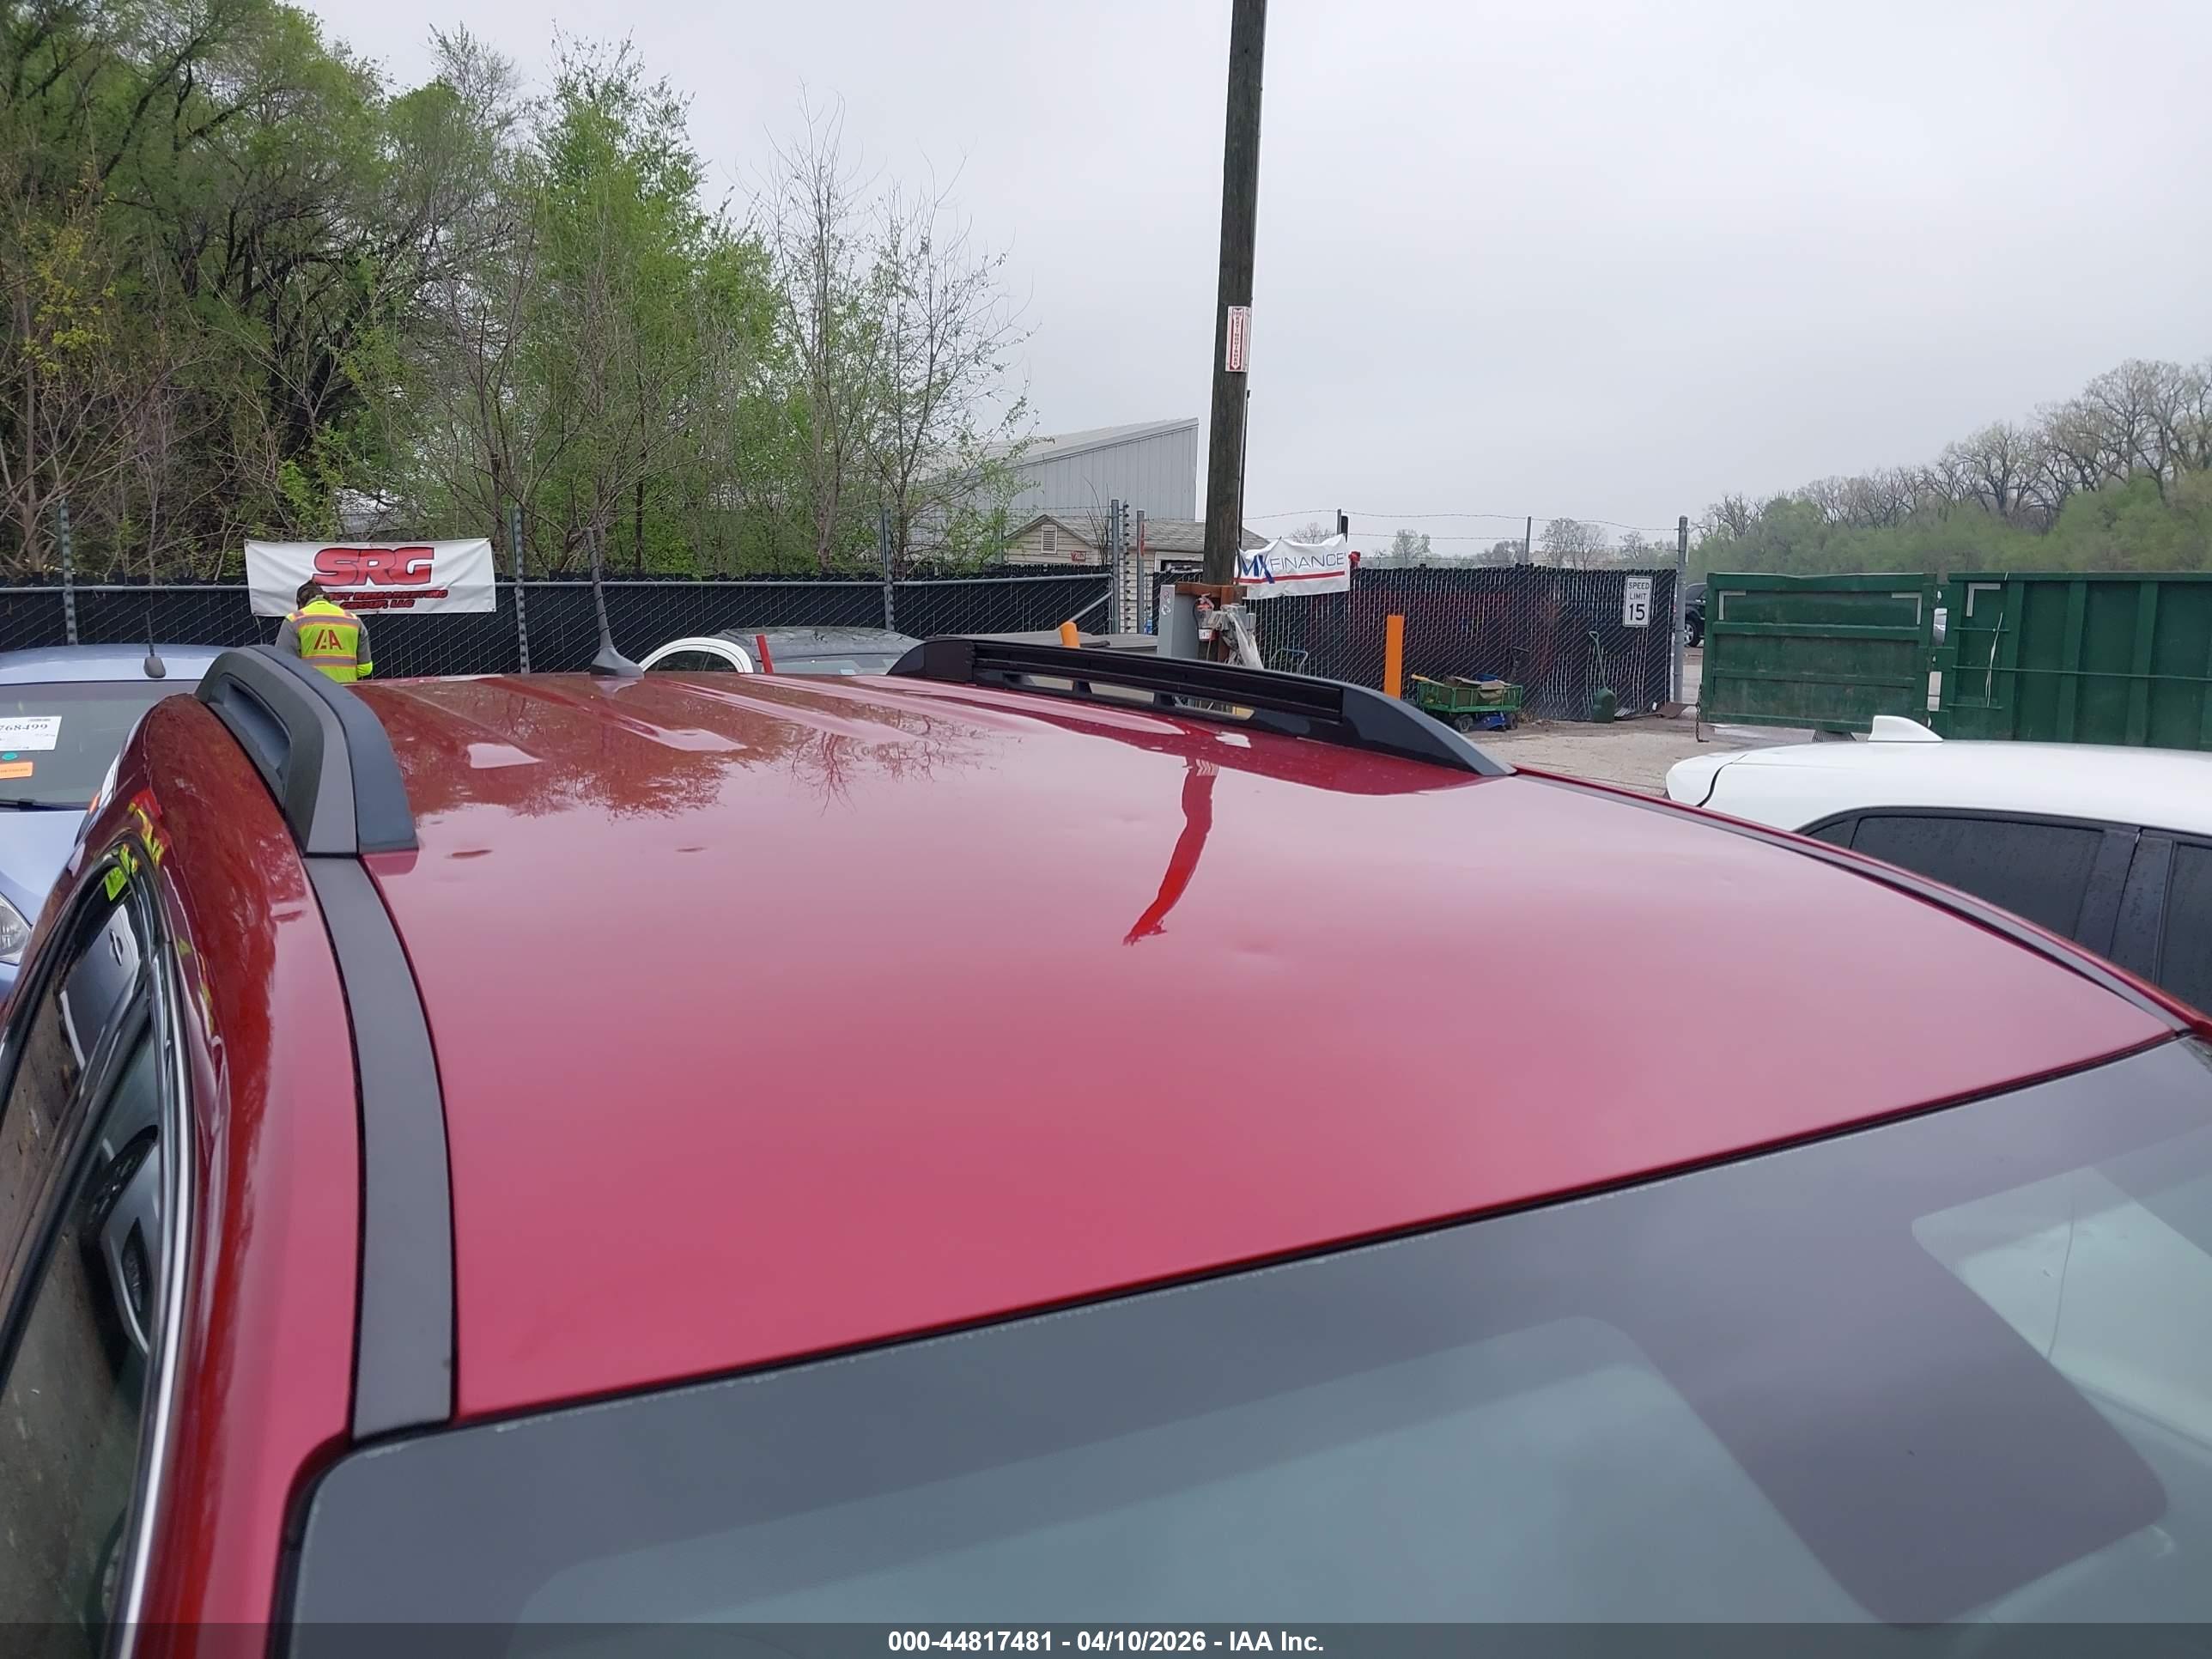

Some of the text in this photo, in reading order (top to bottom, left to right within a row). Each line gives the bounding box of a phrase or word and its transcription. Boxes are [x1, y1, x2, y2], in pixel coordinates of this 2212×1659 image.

[313, 547, 434, 586] SRG
[1270, 553, 1344, 570] FINANCE
[1629, 604, 1645, 621] 15
